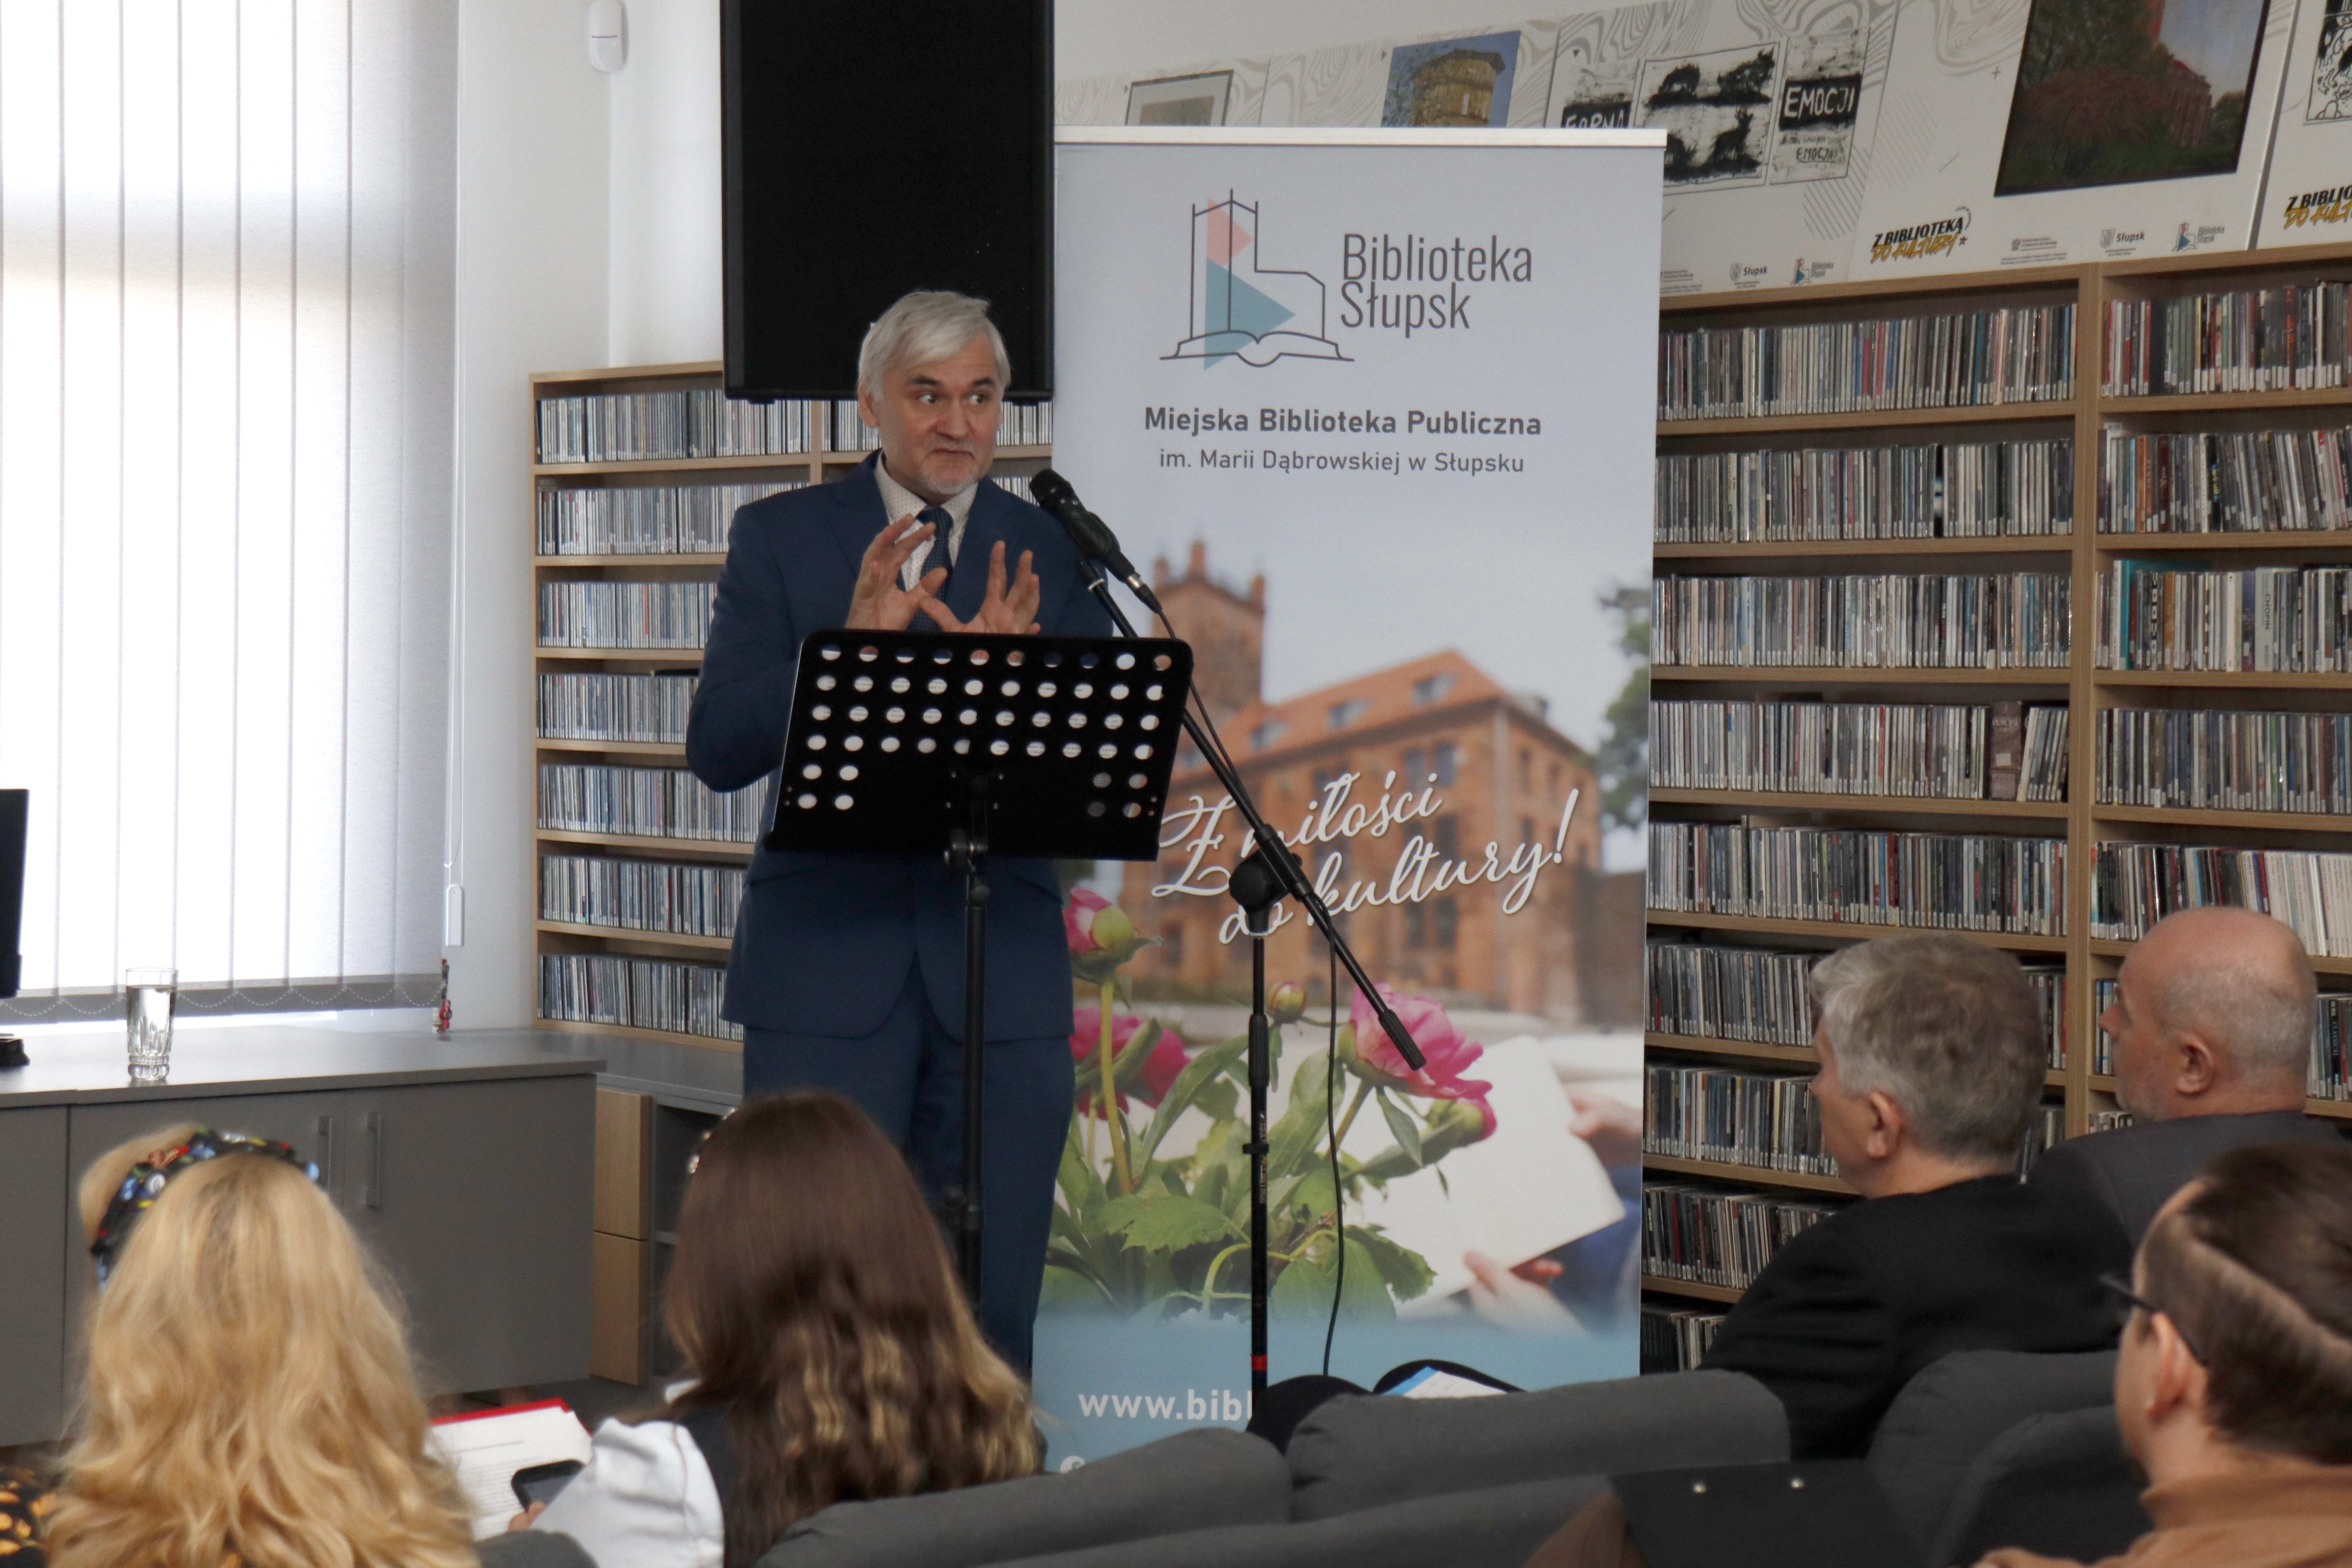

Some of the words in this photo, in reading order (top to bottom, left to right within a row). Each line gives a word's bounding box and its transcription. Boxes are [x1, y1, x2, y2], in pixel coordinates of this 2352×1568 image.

[1784, 86, 1855, 119] EMOCJI
[2283, 207, 2309, 230] DO
[2285, 196, 2299, 213] Z
[1870, 244, 1892, 264] DO
[1892, 231, 1961, 261] KULTURY
[1872, 234, 1883, 250] Z
[1884, 217, 1963, 245] BIBLIOTEKA
[2117, 232, 2145, 243] Słupsk
[1344, 234, 1532, 282] Biblioteka
[1744, 266, 1768, 277] Słupsk
[1341, 281, 1470, 339] Słupsk
[1145, 407, 1248, 436] Miejska
[1260, 408, 1396, 433] Biblioteka
[1408, 410, 1541, 435] Publiczna
[1160, 449, 1191, 468] im.
[1200, 450, 1253, 468] Marii
[1264, 450, 1399, 475] Dąbrowskiej
[1408, 457, 1426, 470] w
[1435, 452, 1523, 476] Słupsku
[1152, 795, 1237, 897] Z
[1306, 788, 1579, 926] kultury!
